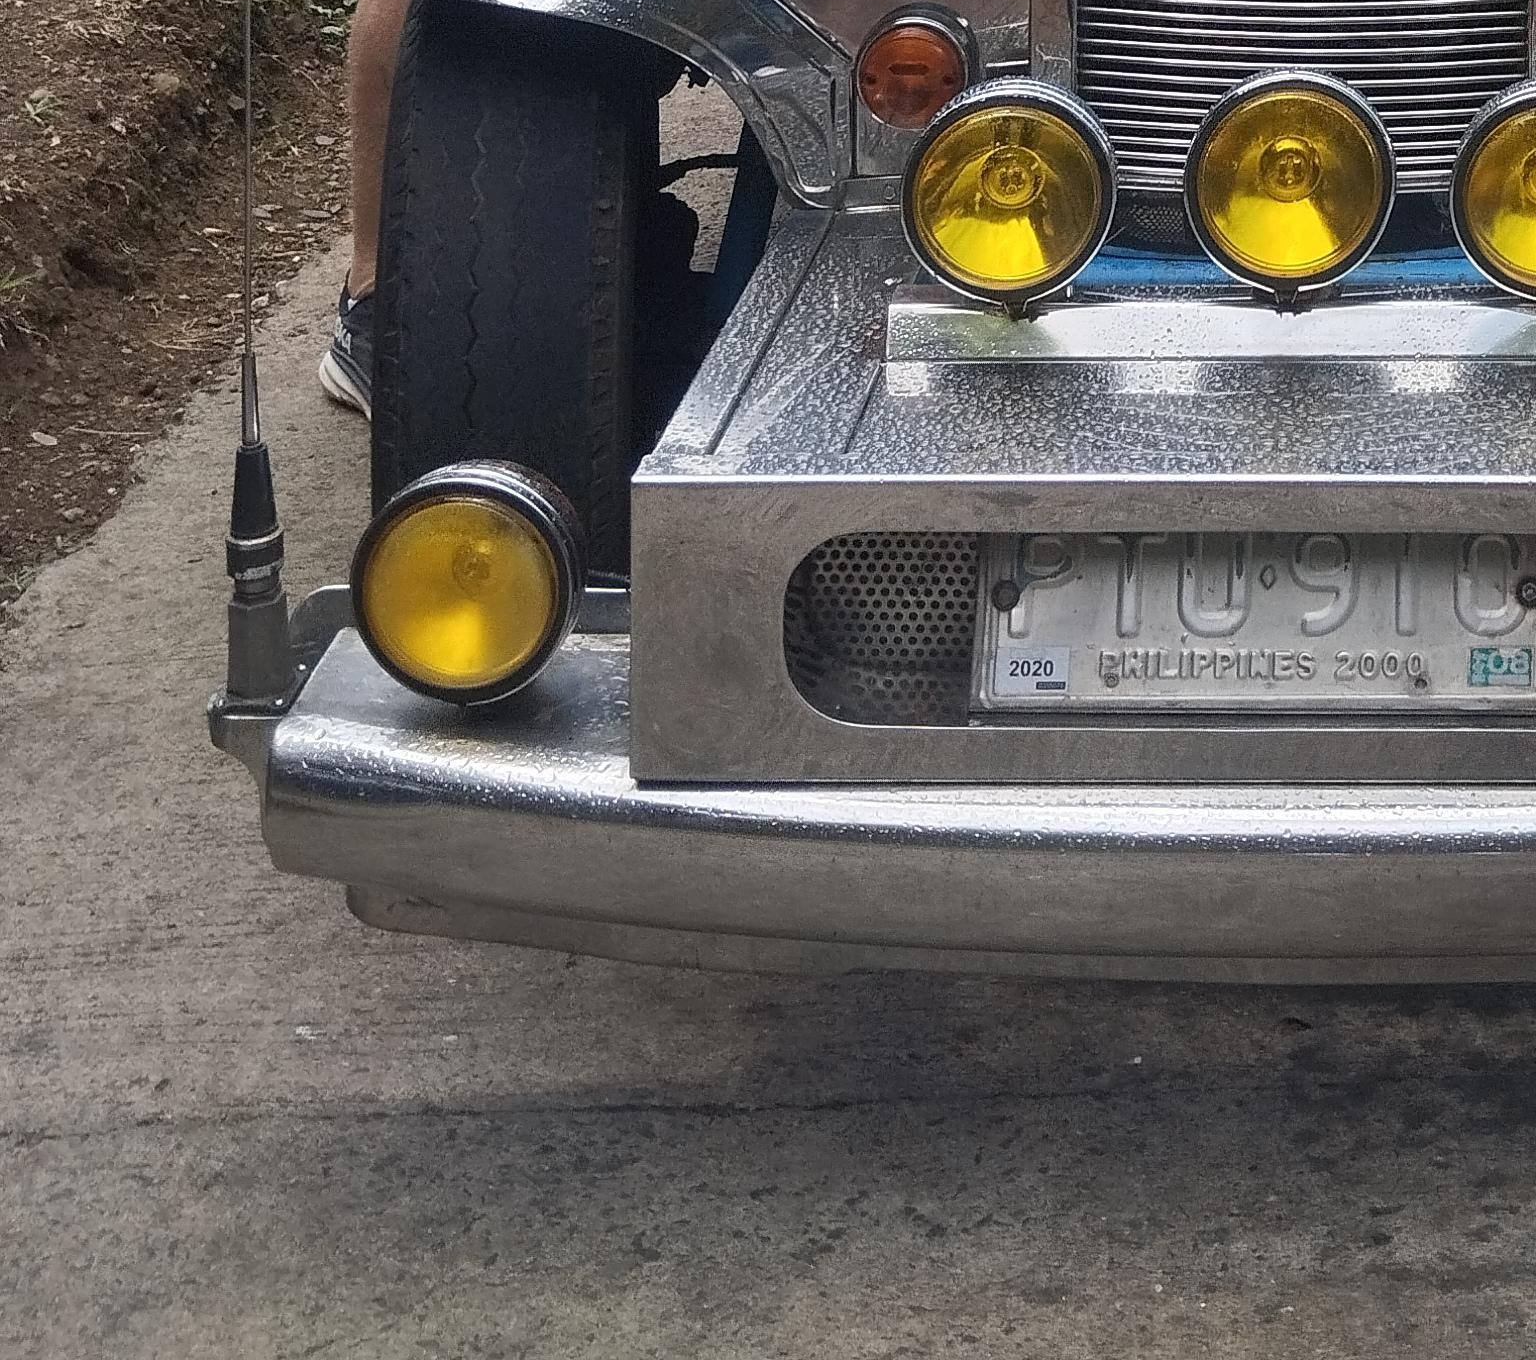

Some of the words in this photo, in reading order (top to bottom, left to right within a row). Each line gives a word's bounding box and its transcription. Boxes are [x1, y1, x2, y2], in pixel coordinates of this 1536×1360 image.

[1009, 660, 1054, 677] 2020
[1098, 648, 1317, 681] PHILIPPINES
[1333, 648, 1426, 680] 2000
